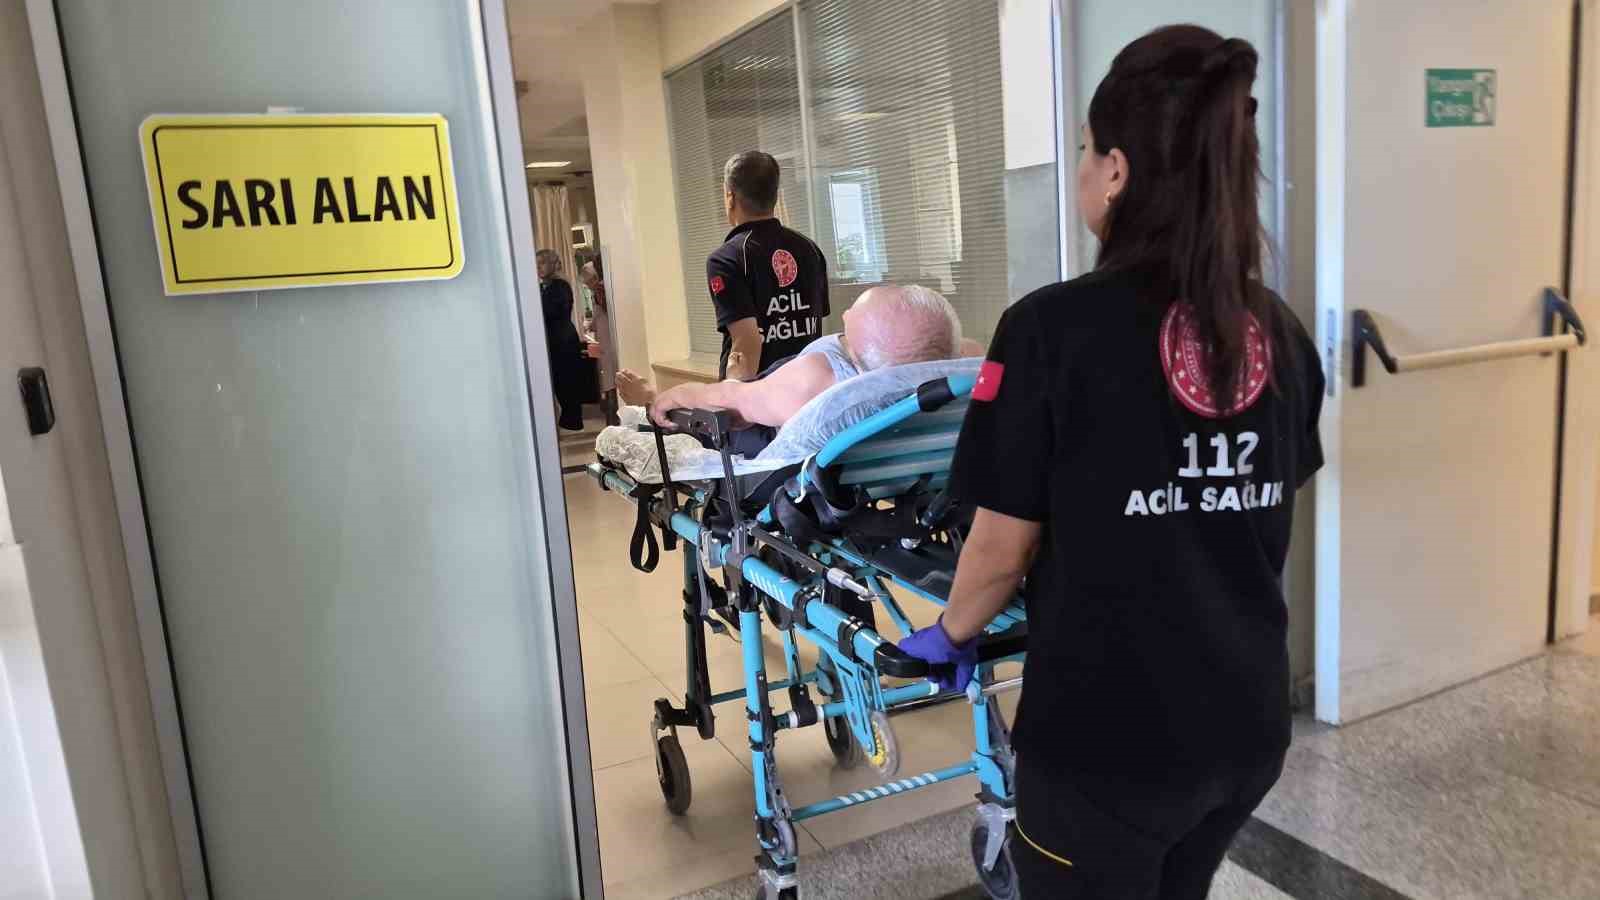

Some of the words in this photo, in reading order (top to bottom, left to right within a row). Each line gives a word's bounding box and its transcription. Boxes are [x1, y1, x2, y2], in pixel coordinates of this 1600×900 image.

[176, 177, 297, 230] SARI
[312, 175, 436, 225] ALAN
[766, 289, 810, 316] ACİL
[1178, 431, 1260, 478] 112
[1124, 481, 1190, 516] ACİL
